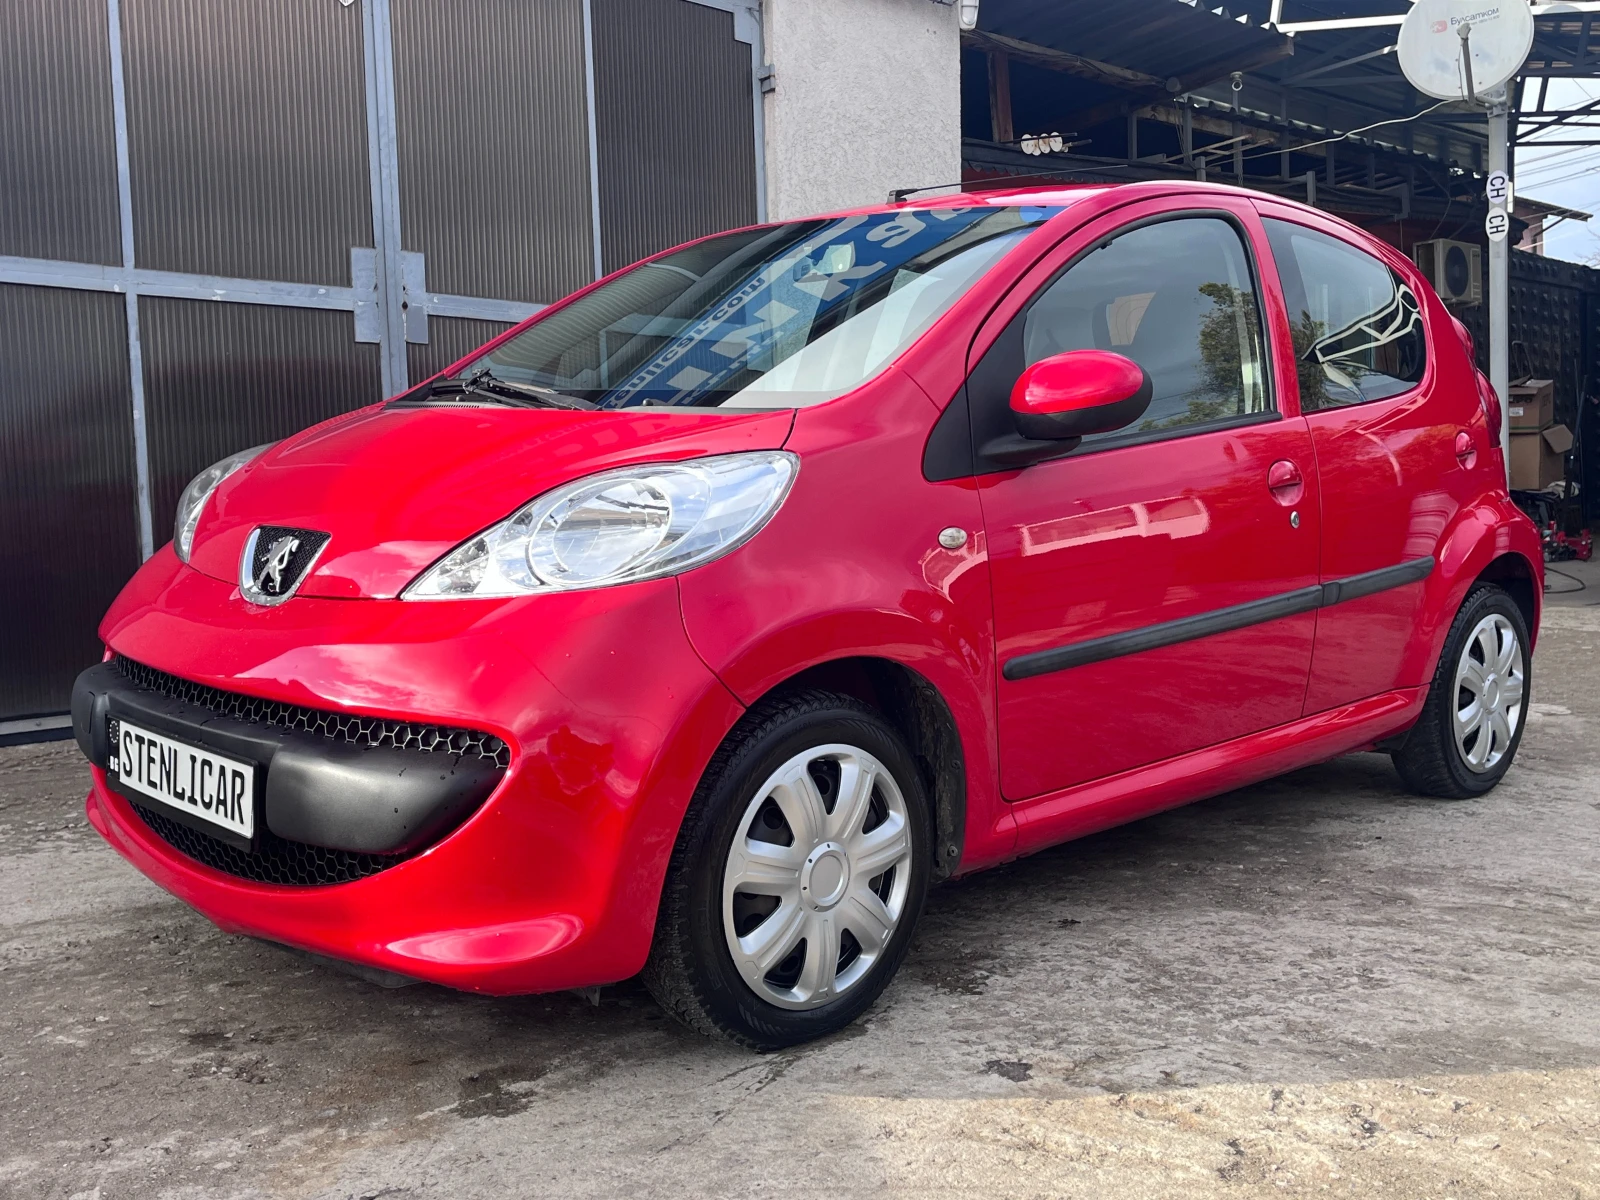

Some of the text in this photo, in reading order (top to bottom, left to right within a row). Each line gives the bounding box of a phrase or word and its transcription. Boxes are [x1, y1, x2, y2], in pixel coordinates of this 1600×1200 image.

[1489, 175, 1506, 199] CH
[1488, 214, 1506, 235] CH
[123, 730, 245, 825] STENLICAR
